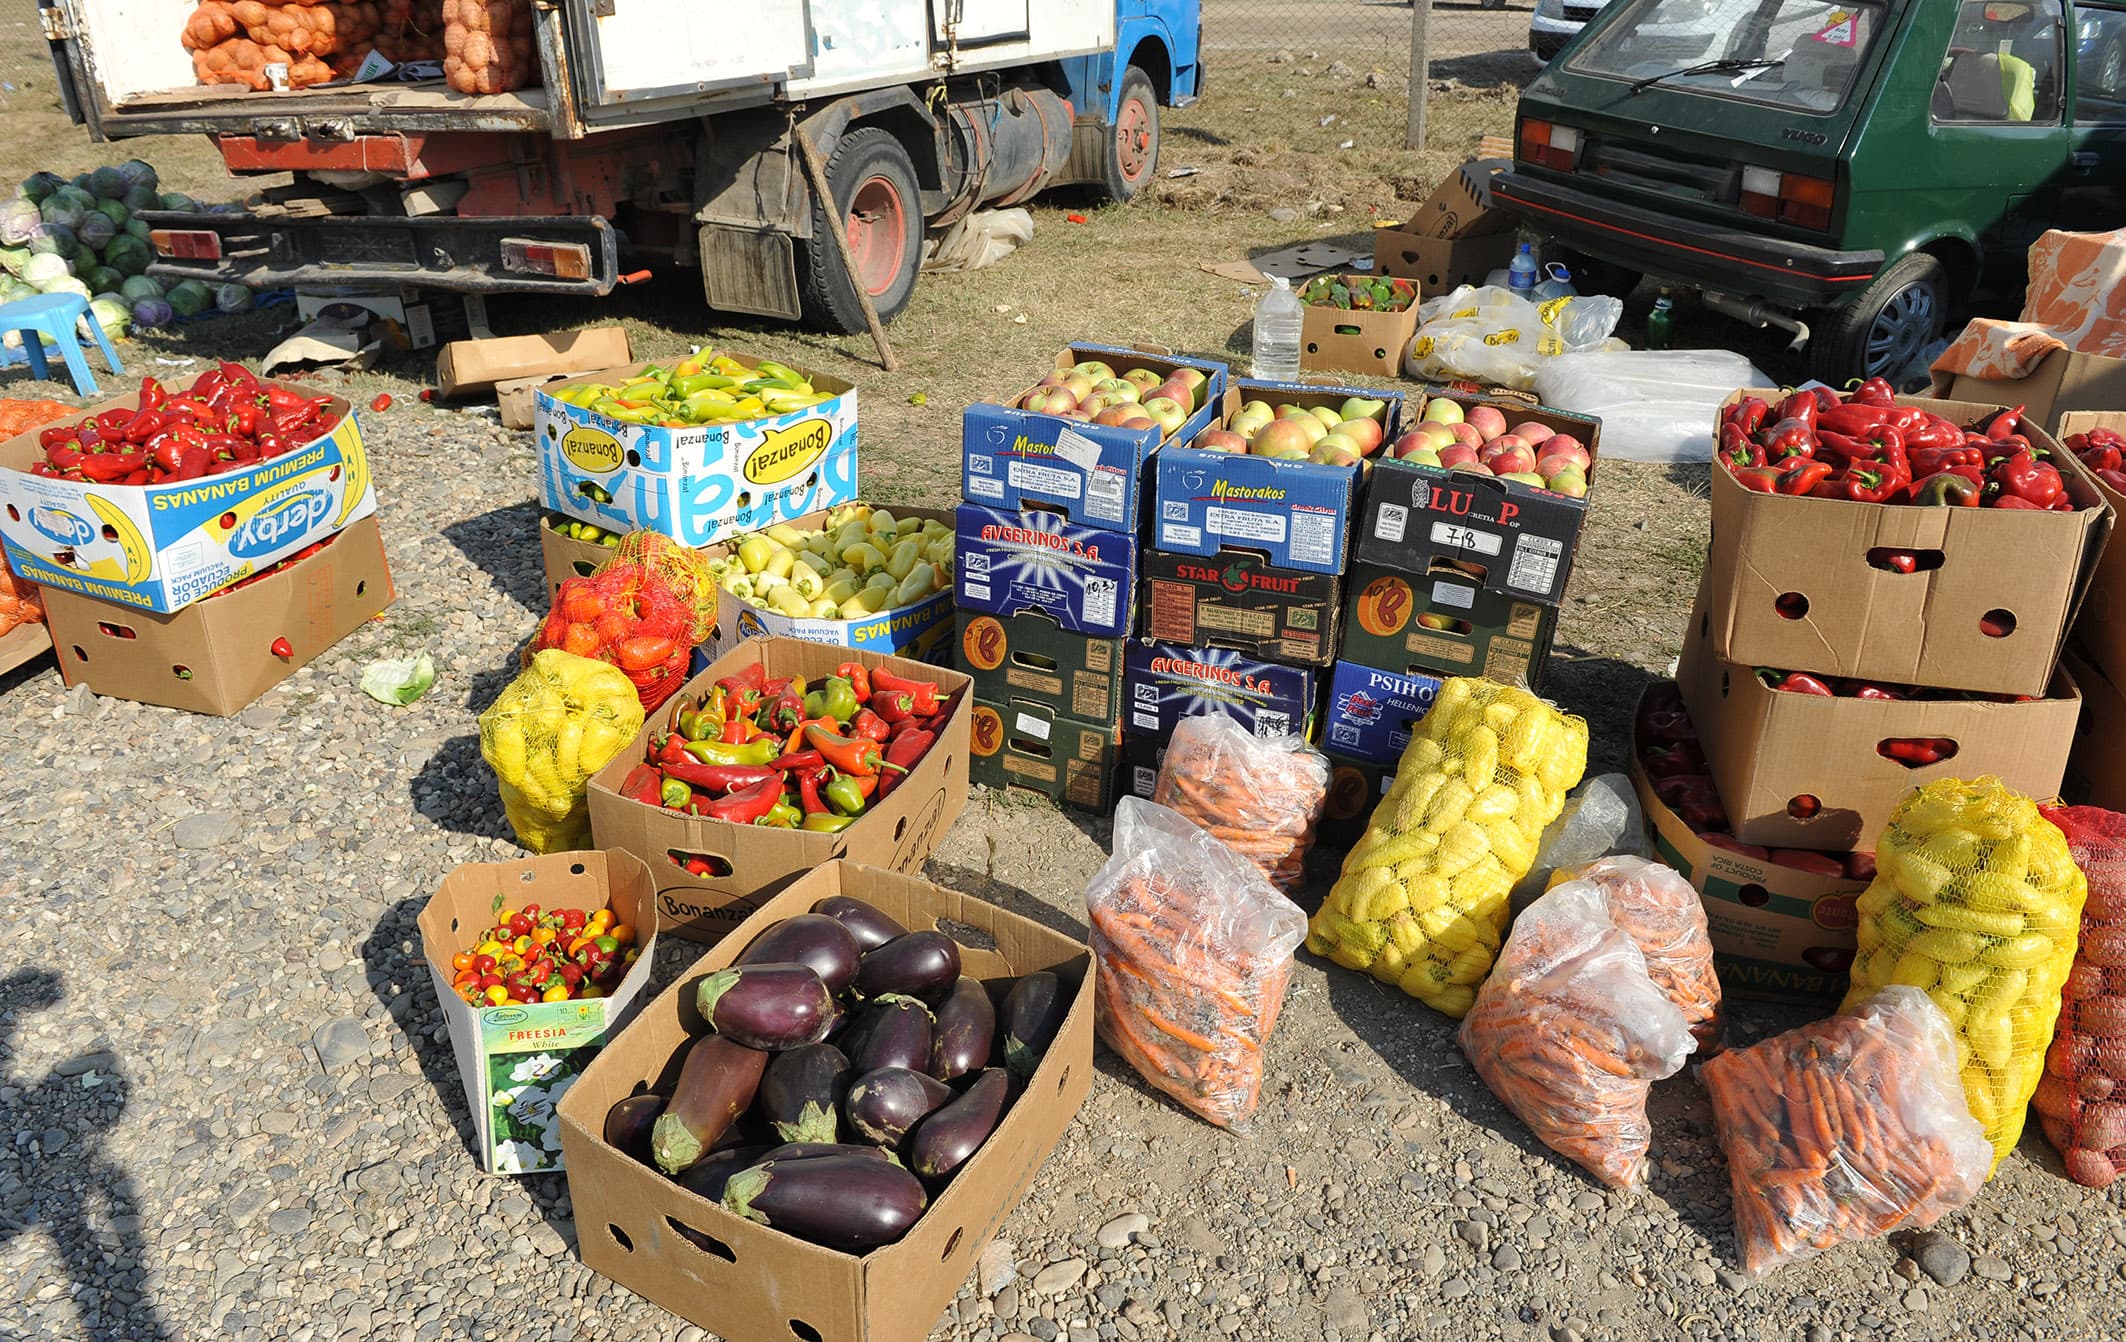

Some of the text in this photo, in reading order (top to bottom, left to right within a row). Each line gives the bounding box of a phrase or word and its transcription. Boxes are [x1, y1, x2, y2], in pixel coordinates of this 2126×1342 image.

[1323, 386, 1369, 394] CITRUS
[587, 414, 629, 439] Bonanza!
[566, 438, 618, 463] Bonanza!
[676, 431, 730, 449] Bonanza!
[1012, 434, 1055, 459] Mastor
[751, 425, 825, 481] Bonanza!
[151, 445, 327, 512] PREMIUM BANANAS
[262, 481, 307, 505] QUALITY
[763, 484, 806, 506] Bonanza!
[1210, 479, 1287, 504] Mastorakos
[234, 492, 328, 551] derby
[707, 509, 753, 533] Bonanza!
[980, 524, 1103, 563] AVGERINOS S.A.
[170, 561, 225, 584] VACUUM PACK
[171, 565, 231, 597] ECUADOR
[1176, 564, 1301, 594] STAR FRUIT
[20, 563, 154, 608] PREMIUM BANANAS
[173, 565, 248, 607] PRODUCE OF
[808, 627, 840, 637] VACUUM
[853, 607, 932, 644] BANANAS
[1150, 656, 1242, 688] AVGERINOS
[1245, 674, 1276, 698] S.A.
[1369, 671, 1438, 701] PSIHO
[1349, 694, 1377, 707] Best
[1710, 862, 1767, 884] PRODUCT OF
[1712, 855, 1763, 876] COSTA RICA
[1714, 962, 1825, 993] BANANA
[508, 1028, 567, 1041] FREESIA
[532, 1039, 561, 1049] White
